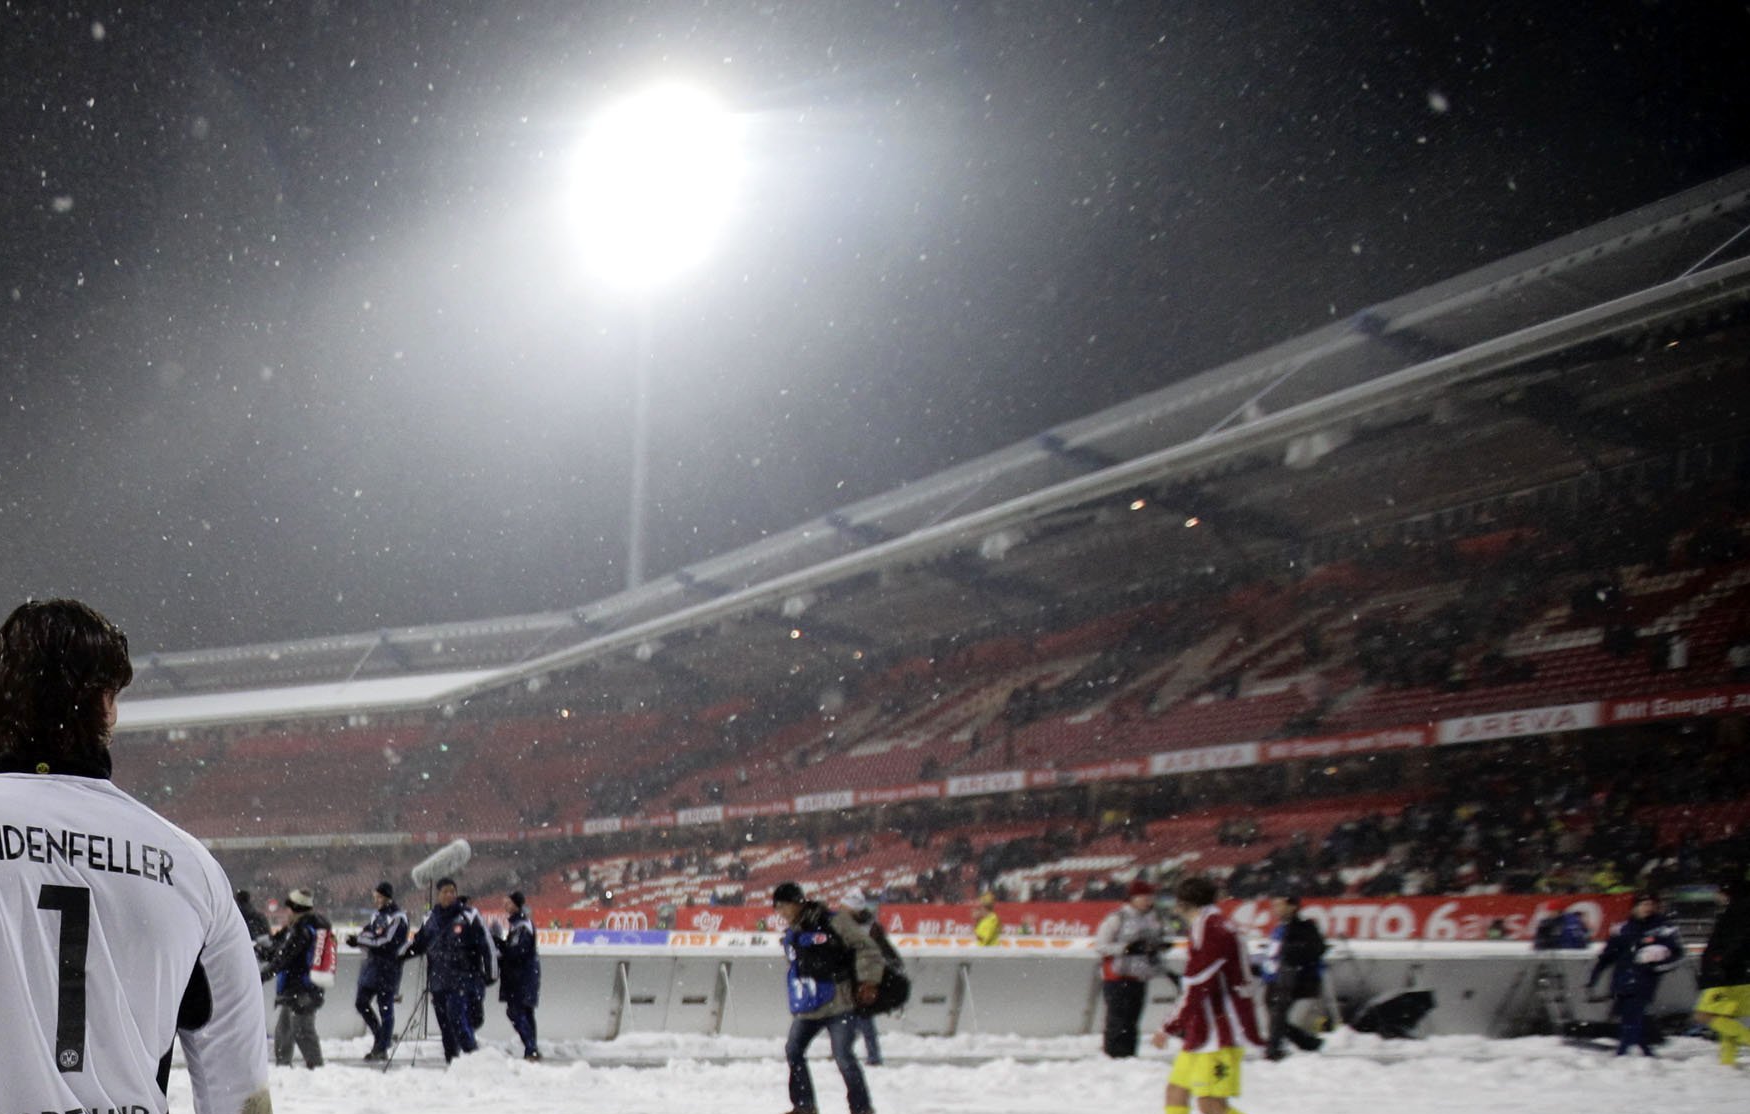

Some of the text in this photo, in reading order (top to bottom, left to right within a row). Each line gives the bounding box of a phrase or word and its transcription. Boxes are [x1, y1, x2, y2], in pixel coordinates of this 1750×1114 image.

[1456, 707, 1577, 739] AREVA
[1298, 903, 1416, 940] OTTO
[37, 884, 90, 1073] 1
